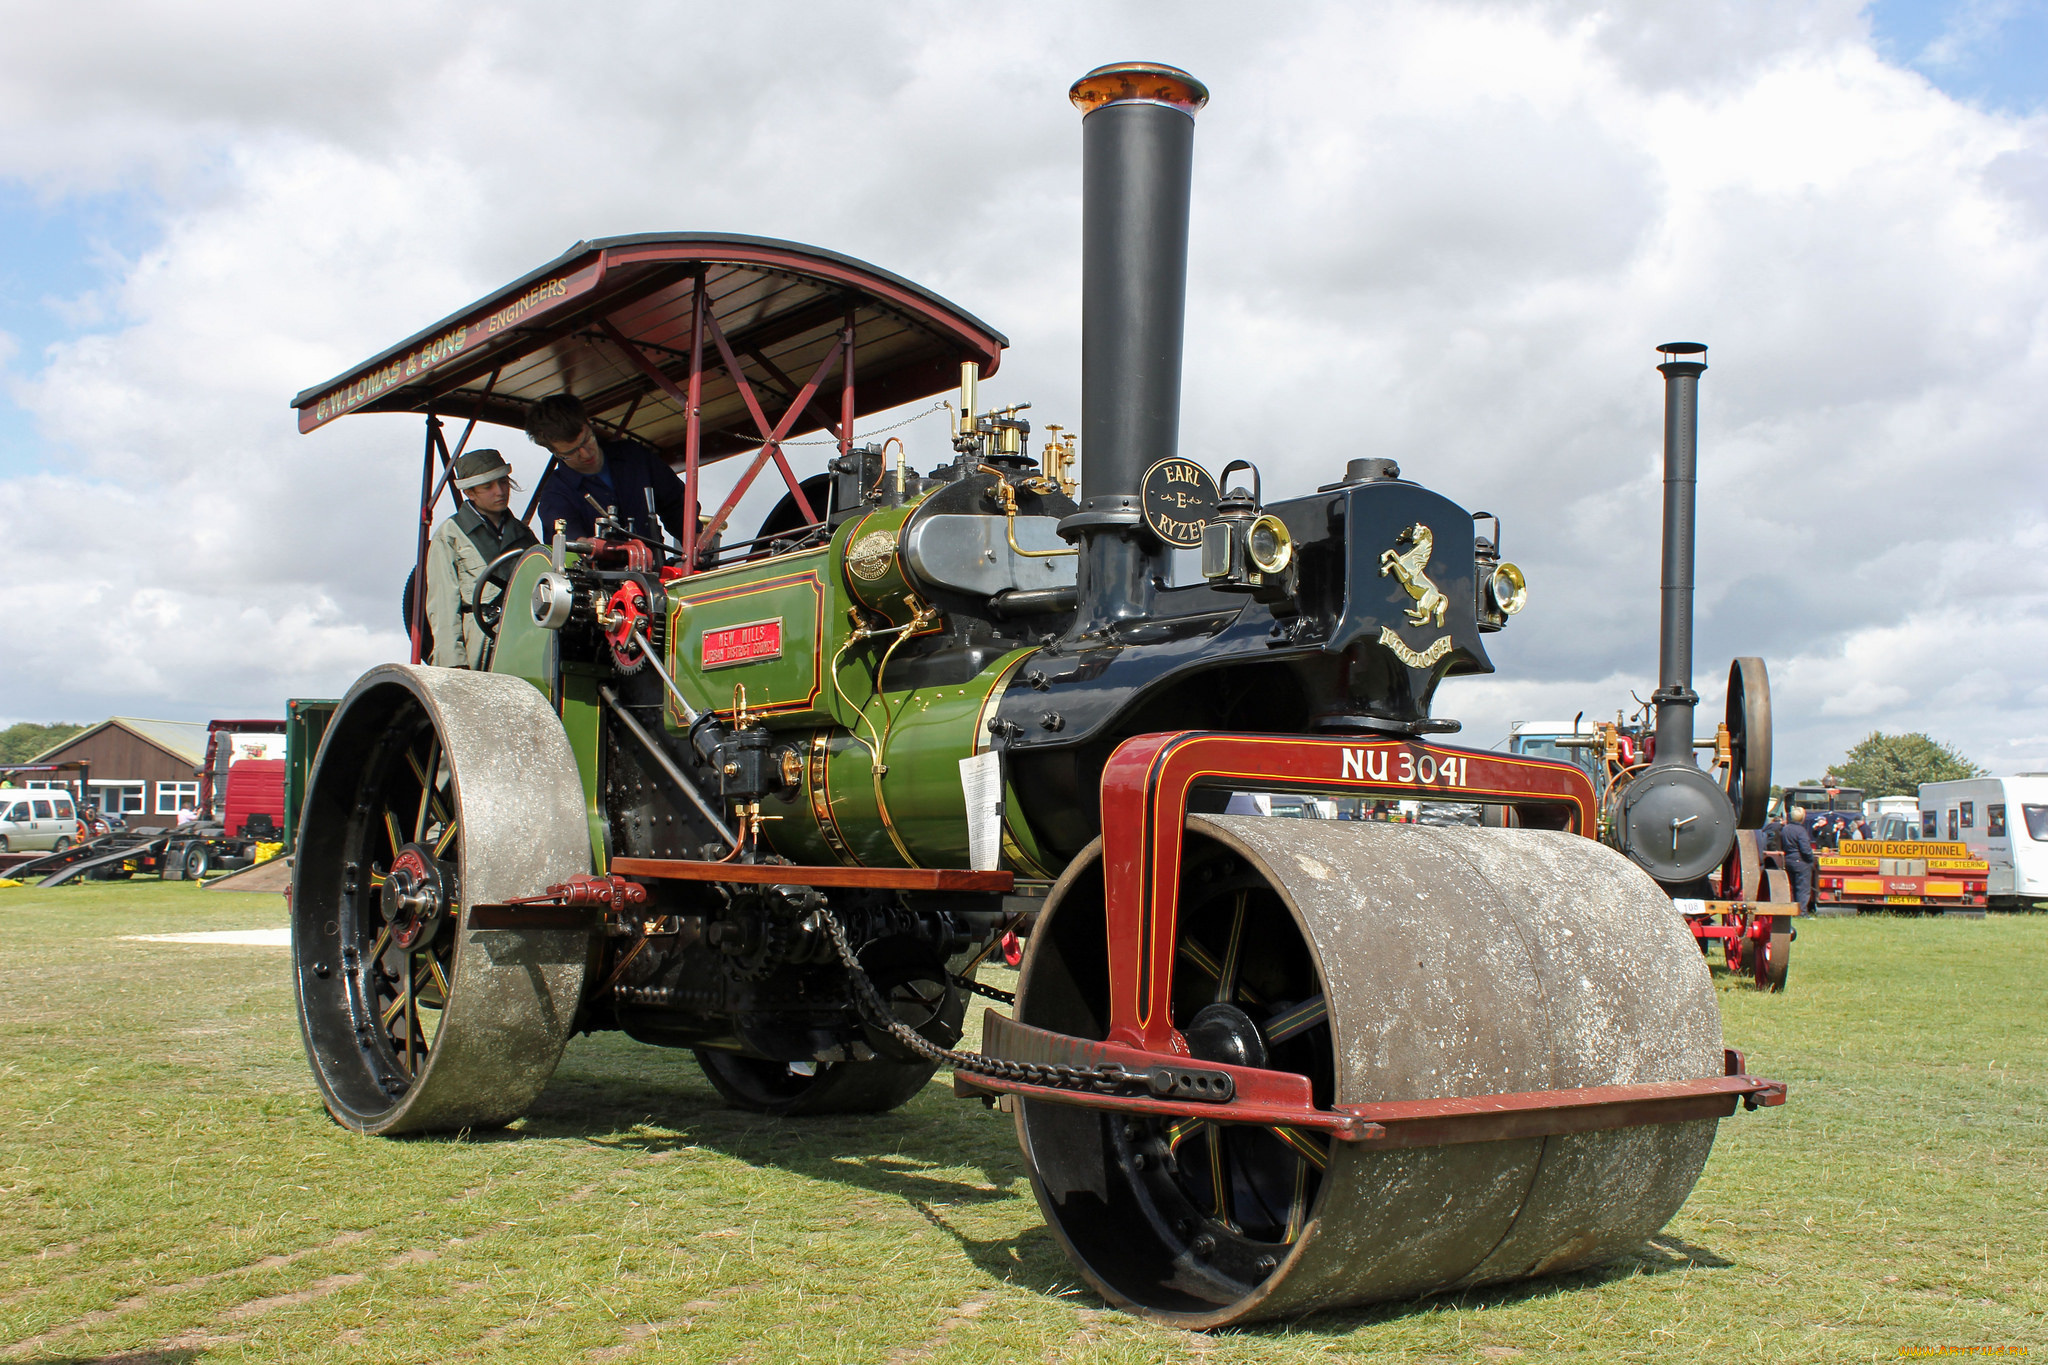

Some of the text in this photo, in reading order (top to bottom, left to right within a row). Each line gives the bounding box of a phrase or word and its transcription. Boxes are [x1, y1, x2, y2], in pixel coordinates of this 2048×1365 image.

[405, 351, 418, 377] &
[421, 324, 467, 369] SONS
[487, 277, 568, 334] ENGINEERS
[1163, 465, 1200, 487] EARL
[1176, 491, 1188, 509] E
[719, 626, 764, 647] NEW MILLS
[1341, 747, 1468, 787] NU 3041
[1886, 844, 1962, 857] EXCEPTIONNEL
[1820, 857, 1877, 866] REAR STEERING
[1930, 860, 1948, 868] REAR
